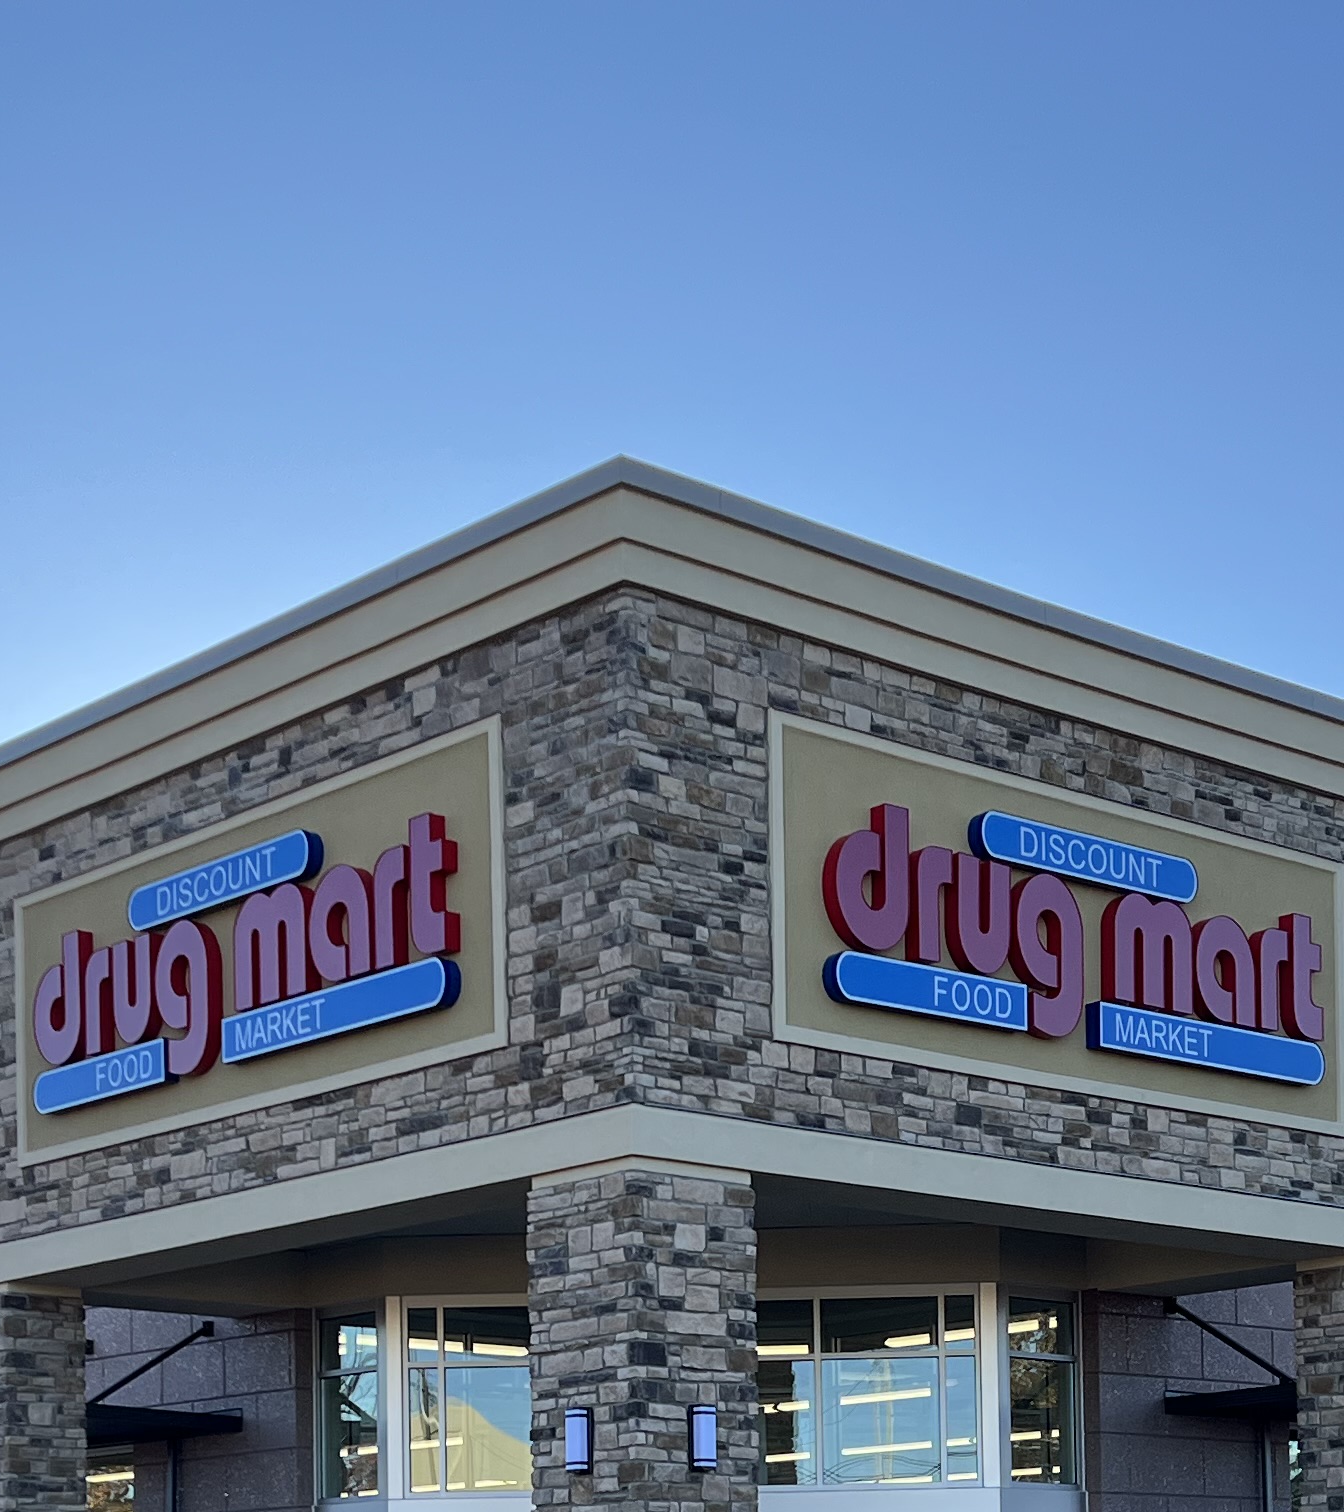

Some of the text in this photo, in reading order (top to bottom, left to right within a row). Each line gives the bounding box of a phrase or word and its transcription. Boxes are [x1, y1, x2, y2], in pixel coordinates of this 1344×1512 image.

[156, 846, 276, 918] DISCOUNT
[1019, 826, 1163, 888] DISCOUNT
[34, 812, 460, 1076] drug mart
[822, 803, 1324, 1041] drug mart
[95, 999, 326, 1092] FOOD MARKET
[933, 975, 1213, 1058] FOOD MARKET
